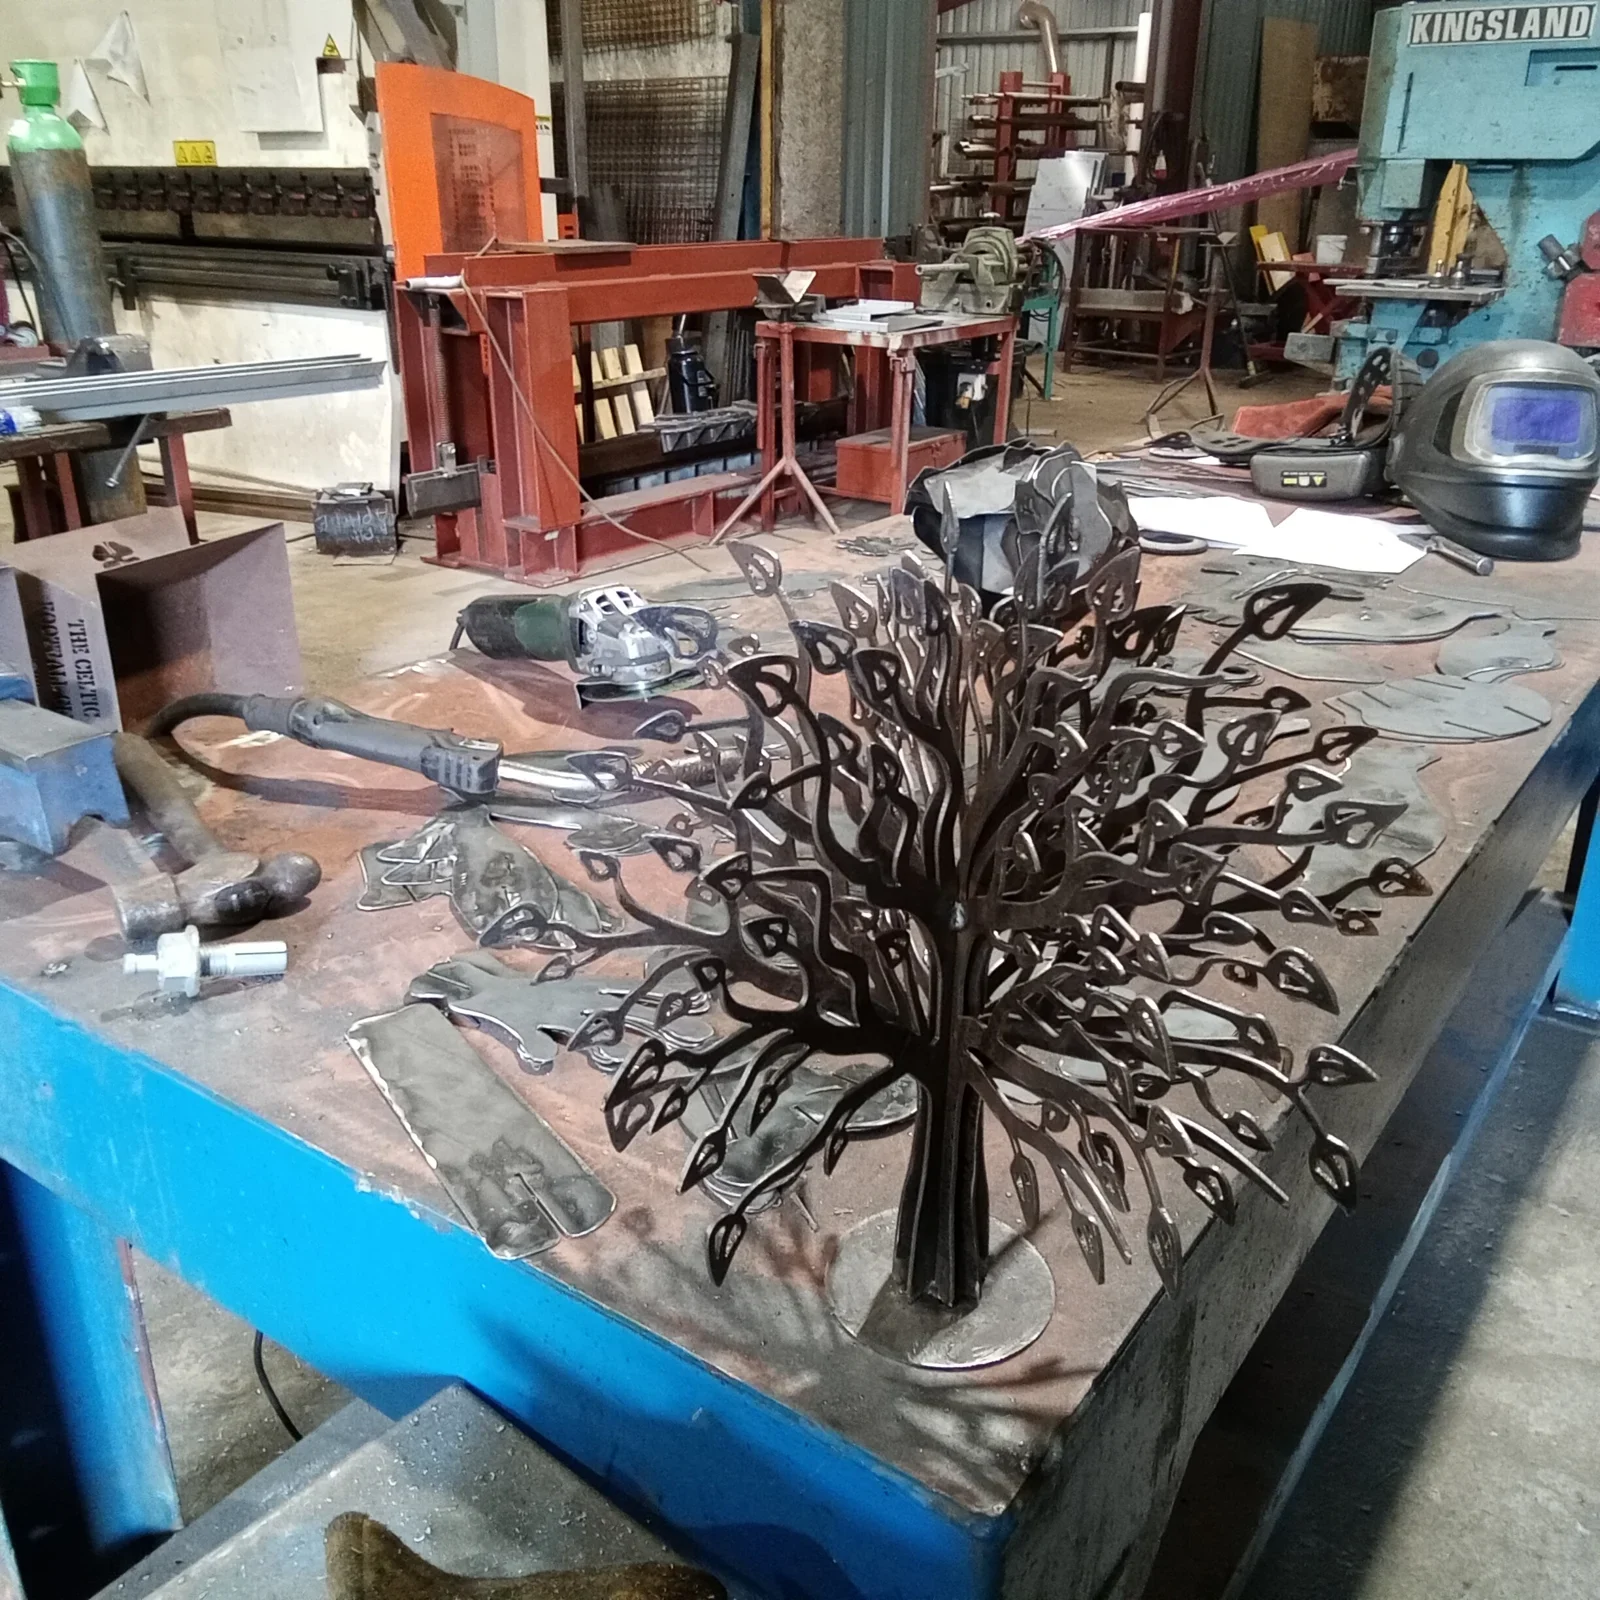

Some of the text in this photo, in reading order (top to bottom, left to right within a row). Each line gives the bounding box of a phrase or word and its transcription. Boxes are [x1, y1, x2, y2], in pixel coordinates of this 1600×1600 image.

[1411, 6, 1591, 44] KINGSLAND
[67, 619, 101, 718] THE CELTIC
